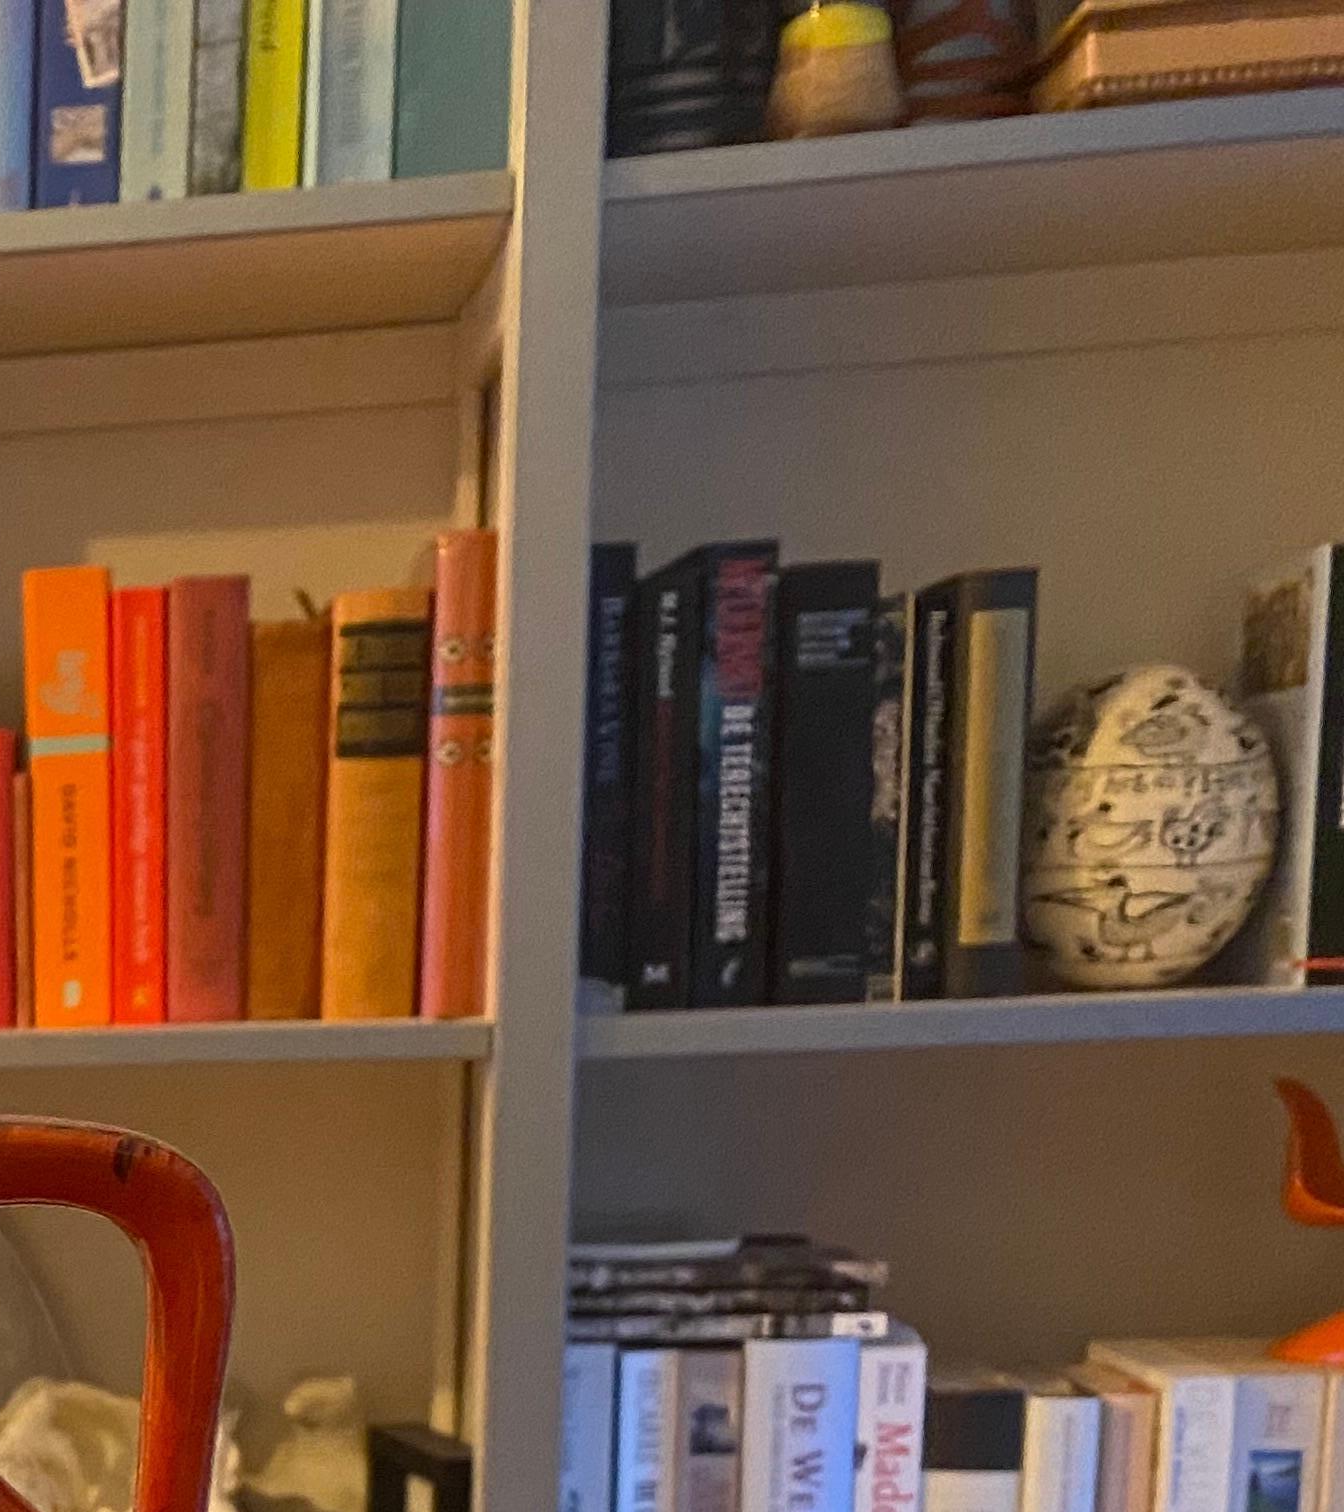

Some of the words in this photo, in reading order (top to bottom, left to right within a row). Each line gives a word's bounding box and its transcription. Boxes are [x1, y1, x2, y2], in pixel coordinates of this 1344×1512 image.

[722, 704, 751, 735] DE
[61, 784, 78, 848] DAVID
[714, 743, 754, 943] TERECHTSTELLING
[61, 856, 80, 961] NICHOLLS
